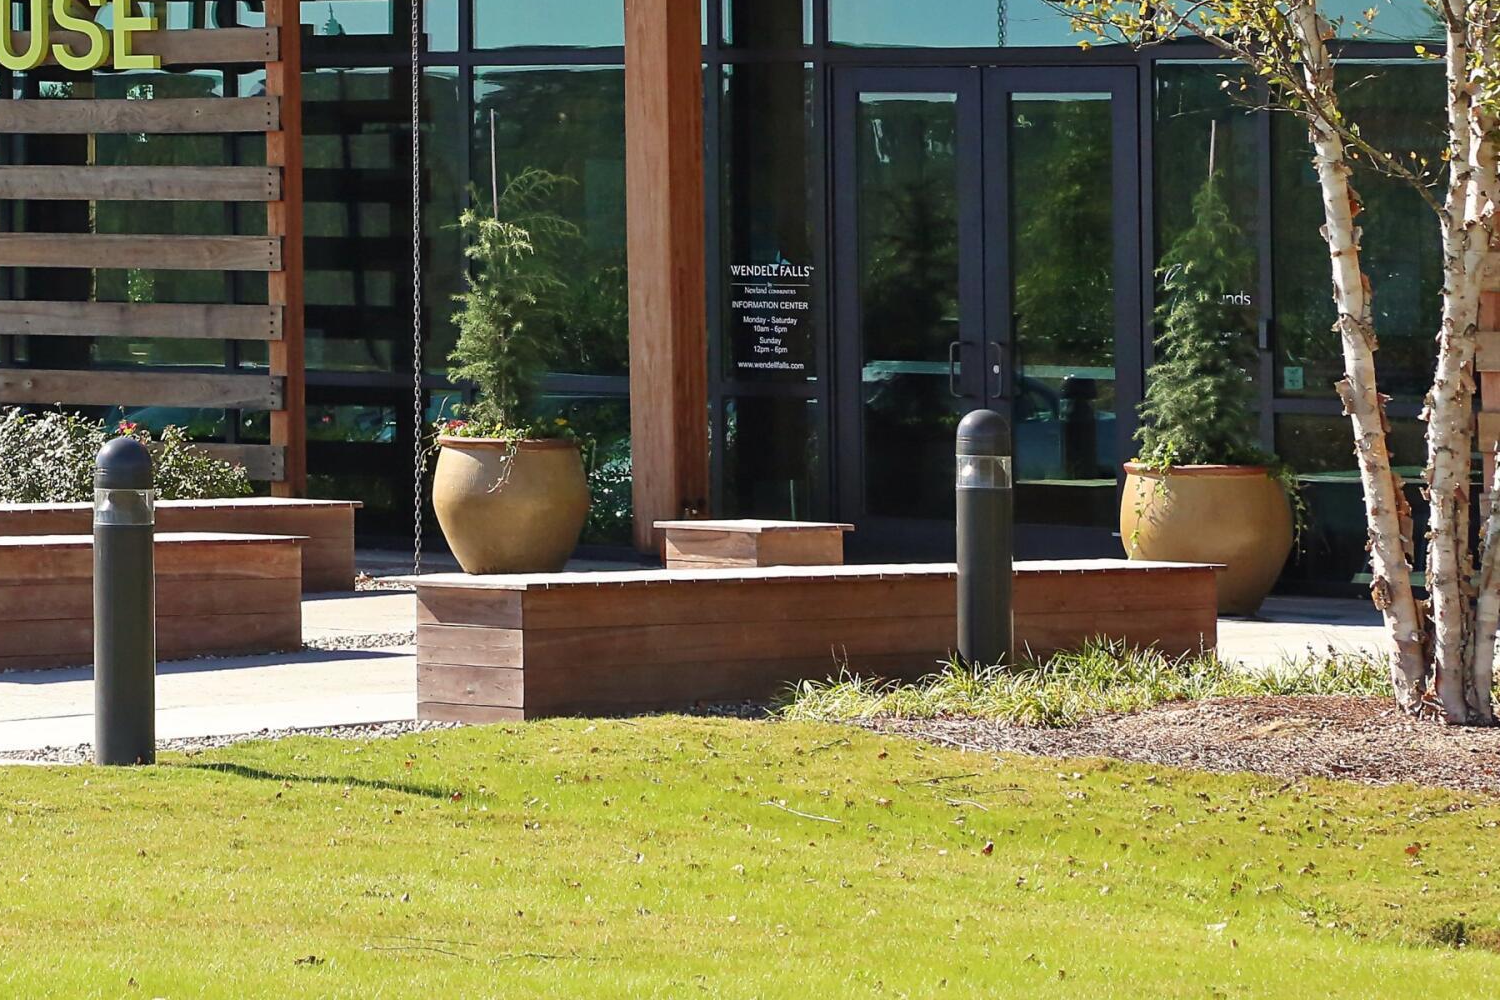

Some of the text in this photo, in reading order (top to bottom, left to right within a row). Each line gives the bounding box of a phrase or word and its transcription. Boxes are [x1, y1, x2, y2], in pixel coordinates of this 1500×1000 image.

[730, 264, 779, 277] WENDELL
[731, 300, 809, 310] INFORMATION CENTER
[743, 315, 767, 325] Monday
[771, 316, 798, 326] Saturday
[759, 336, 782, 345] Sunday
[753, 345, 770, 354] 12pm
[737, 361, 805, 370] www.wendellfalls.com
